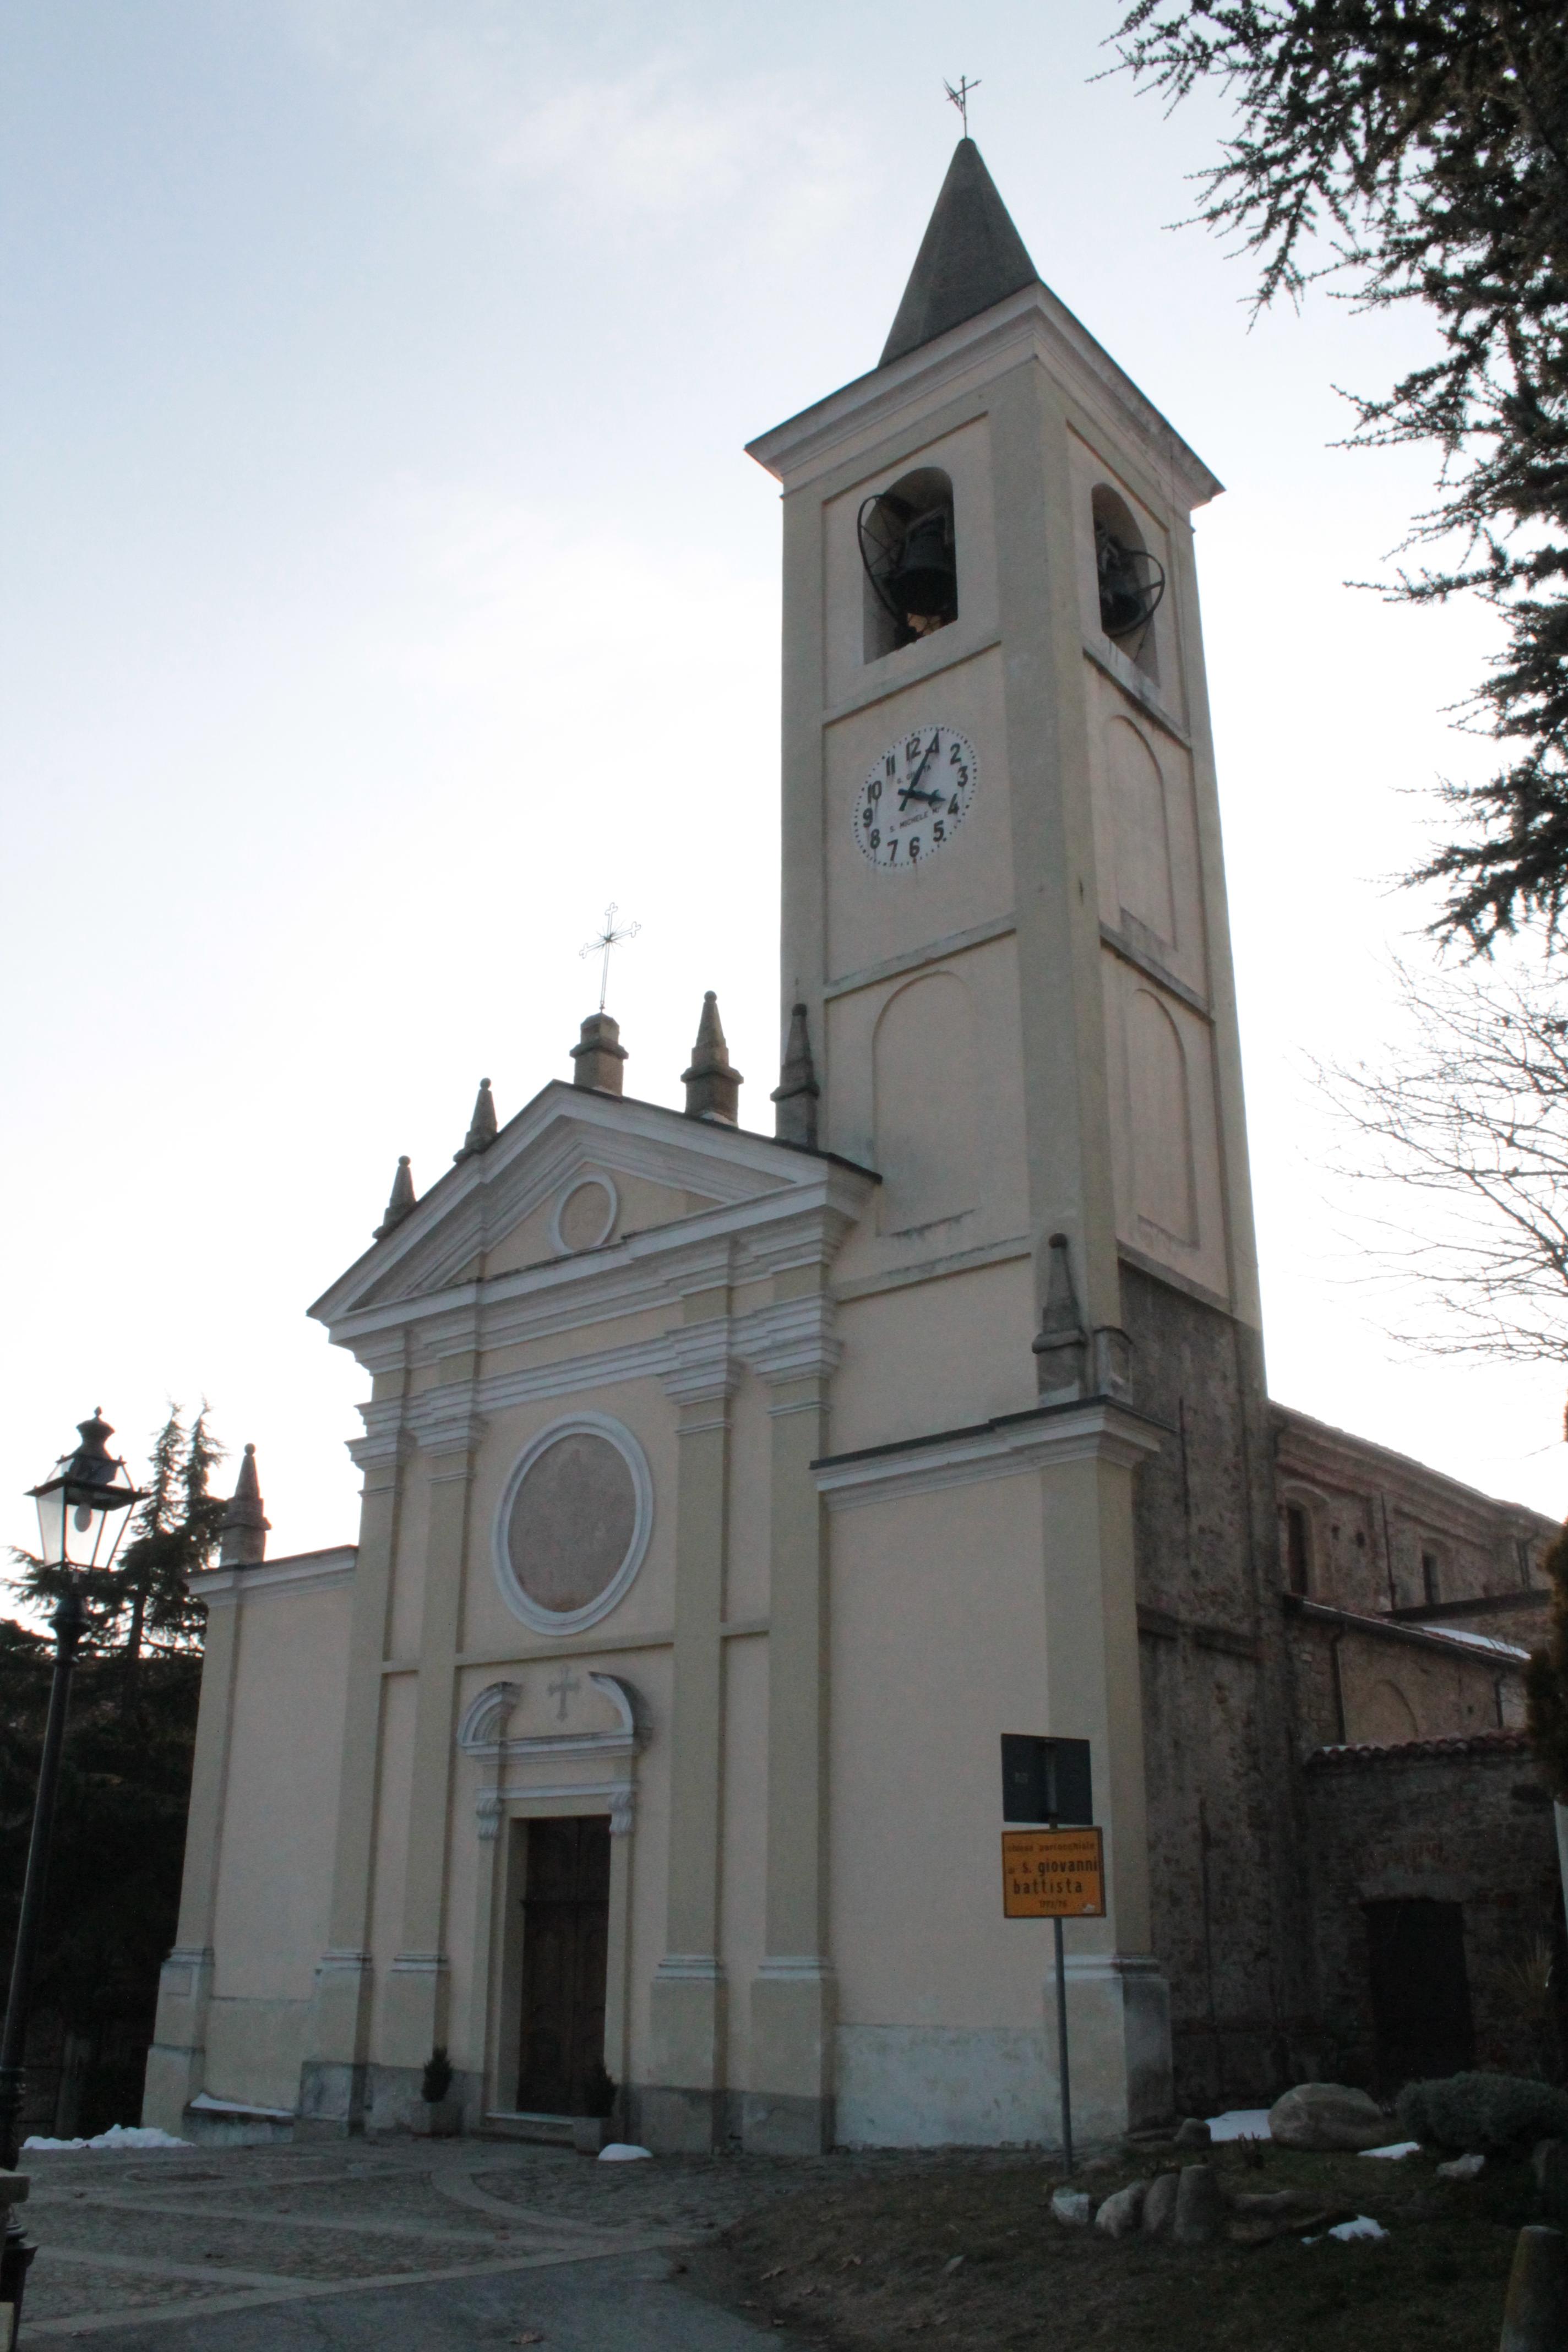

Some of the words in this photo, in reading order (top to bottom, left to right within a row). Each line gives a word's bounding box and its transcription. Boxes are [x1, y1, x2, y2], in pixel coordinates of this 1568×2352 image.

[906, 738, 921, 761] 12
[950, 743, 961, 765] 2
[886, 755, 895, 776] 11
[957, 766, 968, 787] 3
[868, 781, 882, 804] 10
[948, 793, 959, 814] 4
[863, 808, 873, 827] 9
[900, 812, 928, 829] MICHELE
[870, 829, 880, 849] 8
[933, 820, 944, 842] 5
[887, 839, 899, 861] 7
[909, 837, 920, 858] 6
[1038, 1856, 1097, 1876] giovanni
[1013, 1878, 1083, 1894] battista
